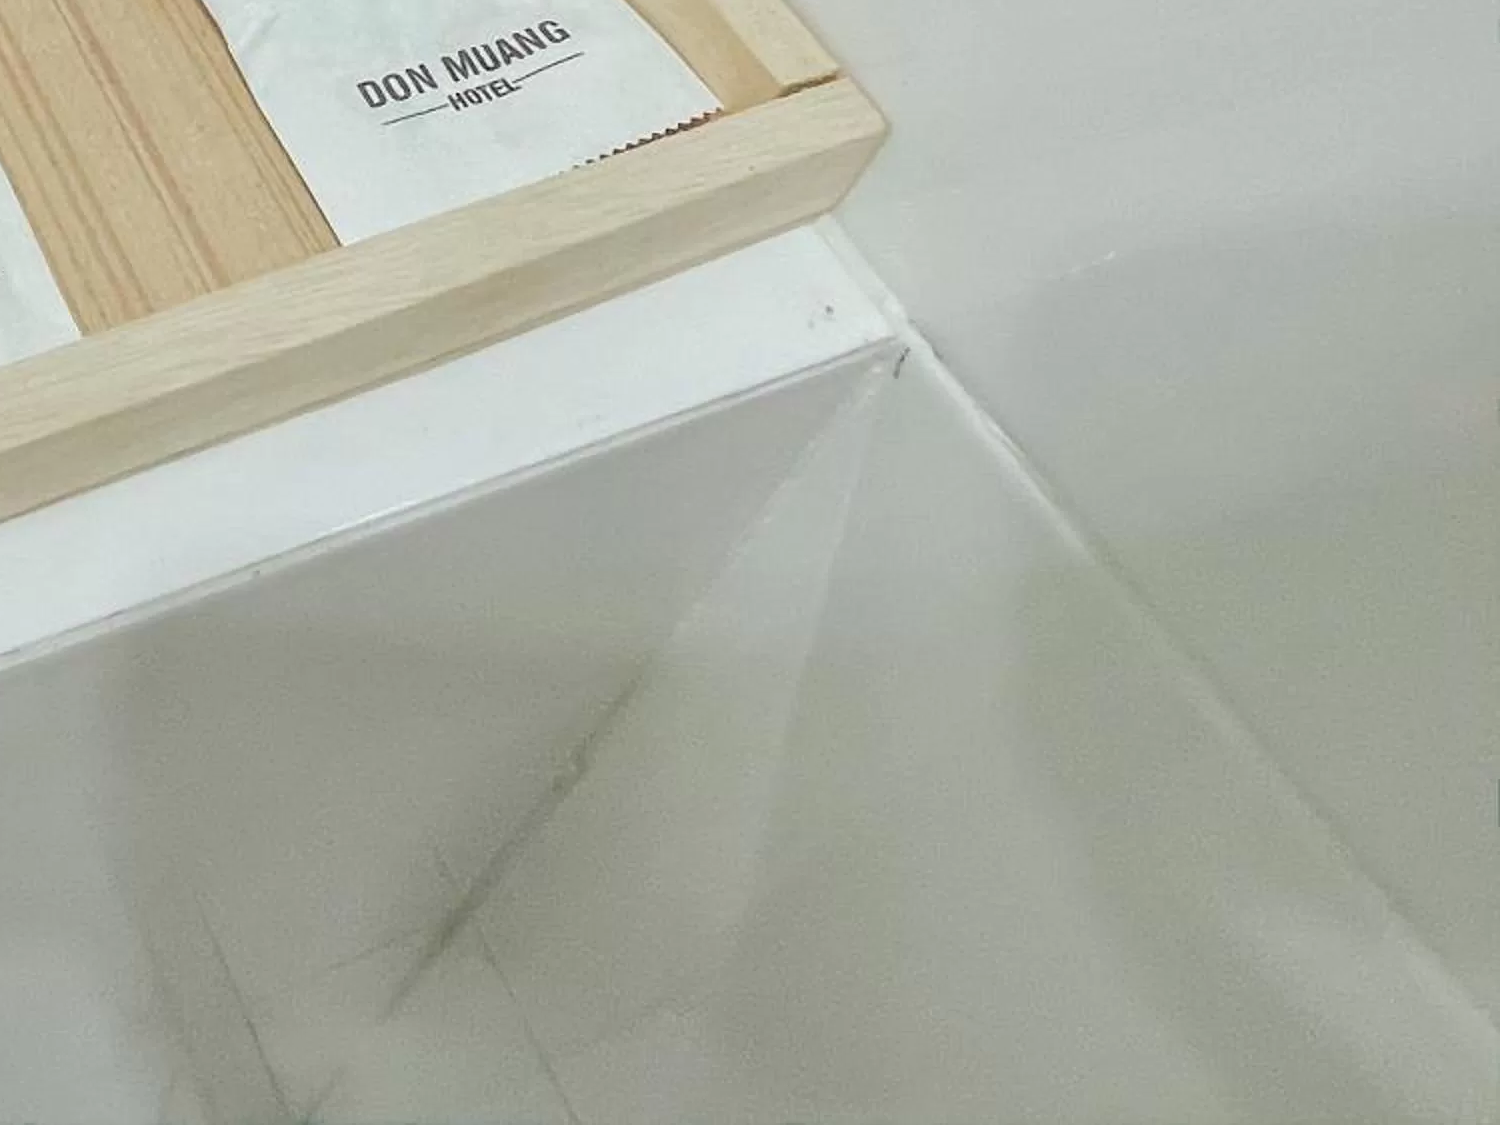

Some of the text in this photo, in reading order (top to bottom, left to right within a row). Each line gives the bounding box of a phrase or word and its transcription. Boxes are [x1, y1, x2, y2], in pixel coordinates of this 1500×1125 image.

[356, 20, 572, 109] DON MUANG
[446, 77, 523, 111] HOTEL
